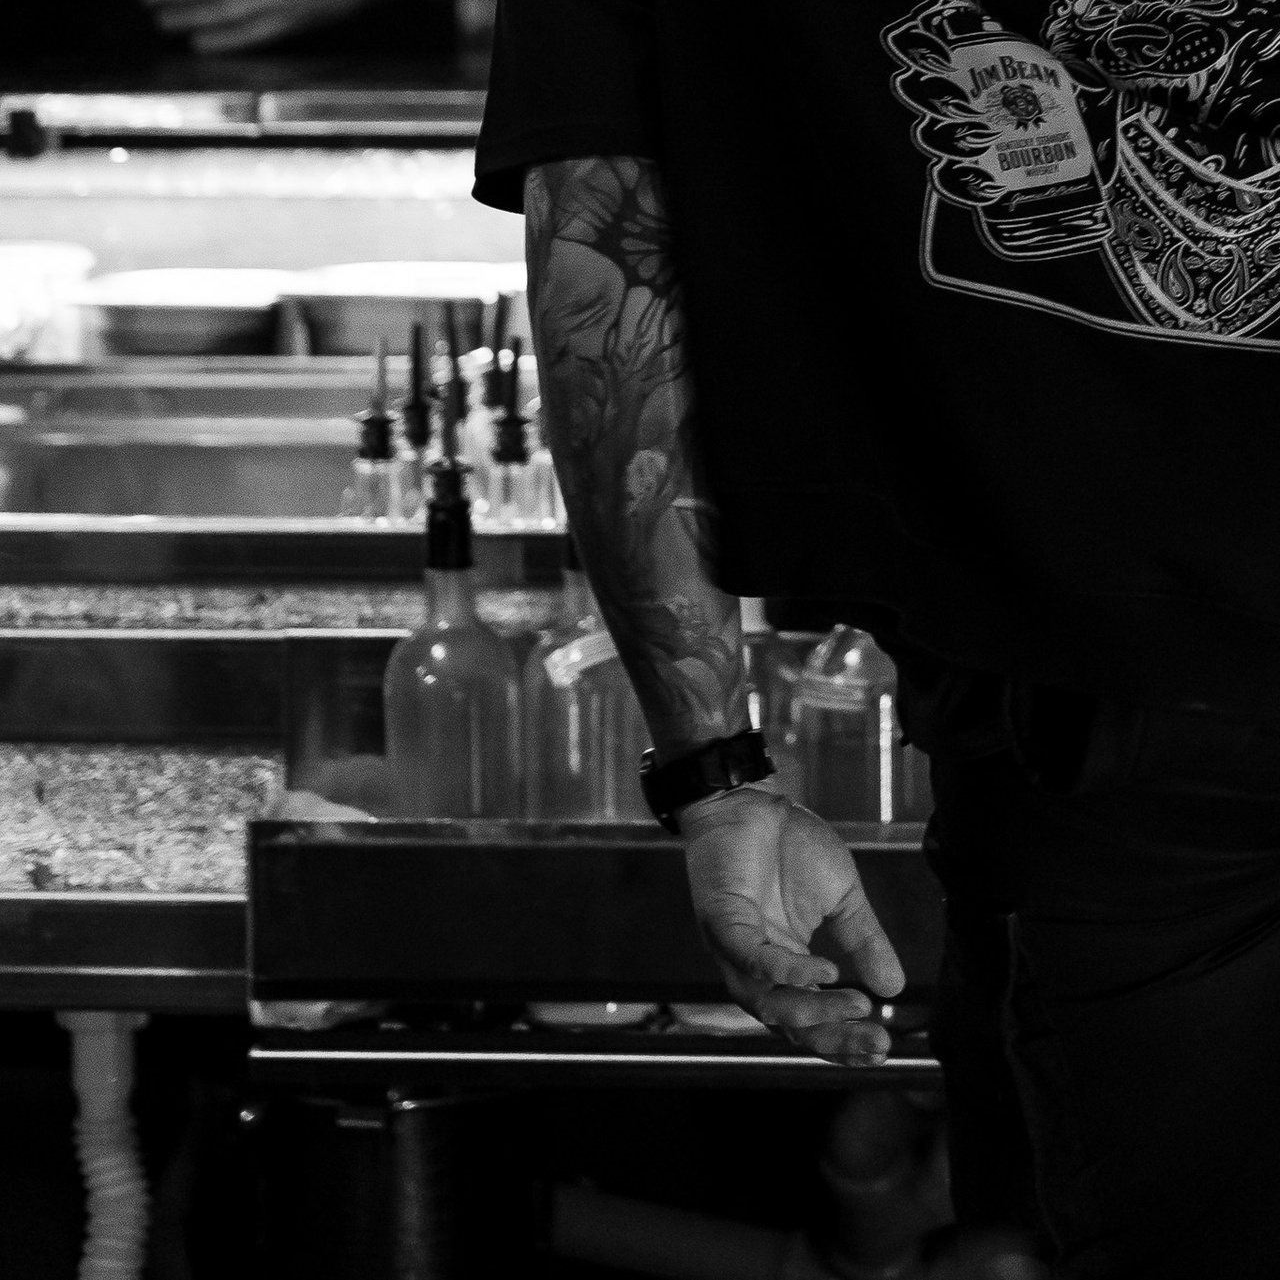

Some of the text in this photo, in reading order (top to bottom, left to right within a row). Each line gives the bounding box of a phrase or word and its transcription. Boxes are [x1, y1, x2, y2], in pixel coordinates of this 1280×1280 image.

[968, 55, 1060, 99] JIM BEAM
[997, 140, 1077, 171] BOURBON
